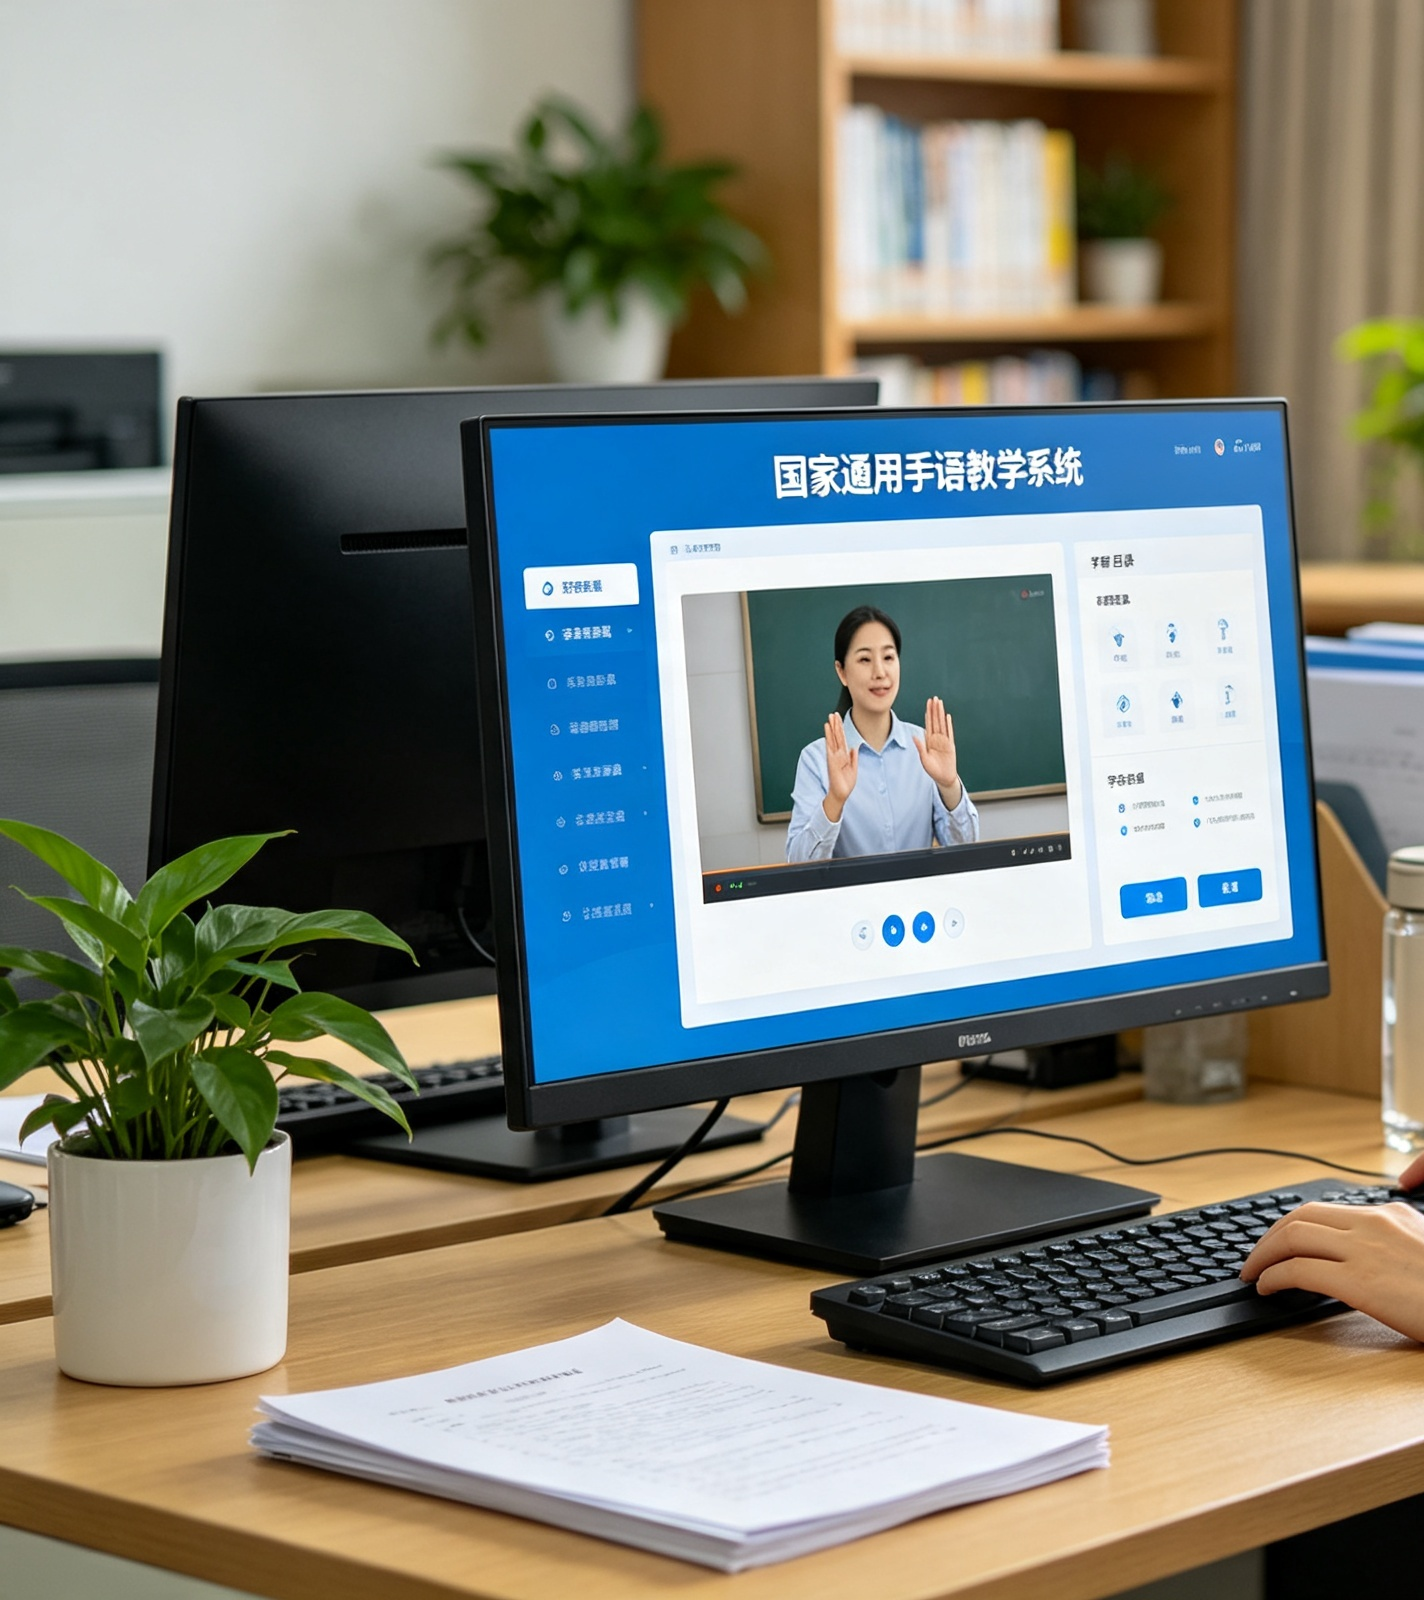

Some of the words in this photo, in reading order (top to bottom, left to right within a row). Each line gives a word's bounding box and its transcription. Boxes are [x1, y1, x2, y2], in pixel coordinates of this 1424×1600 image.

[773, 446, 1084, 499] 国家通用手语教学系统
